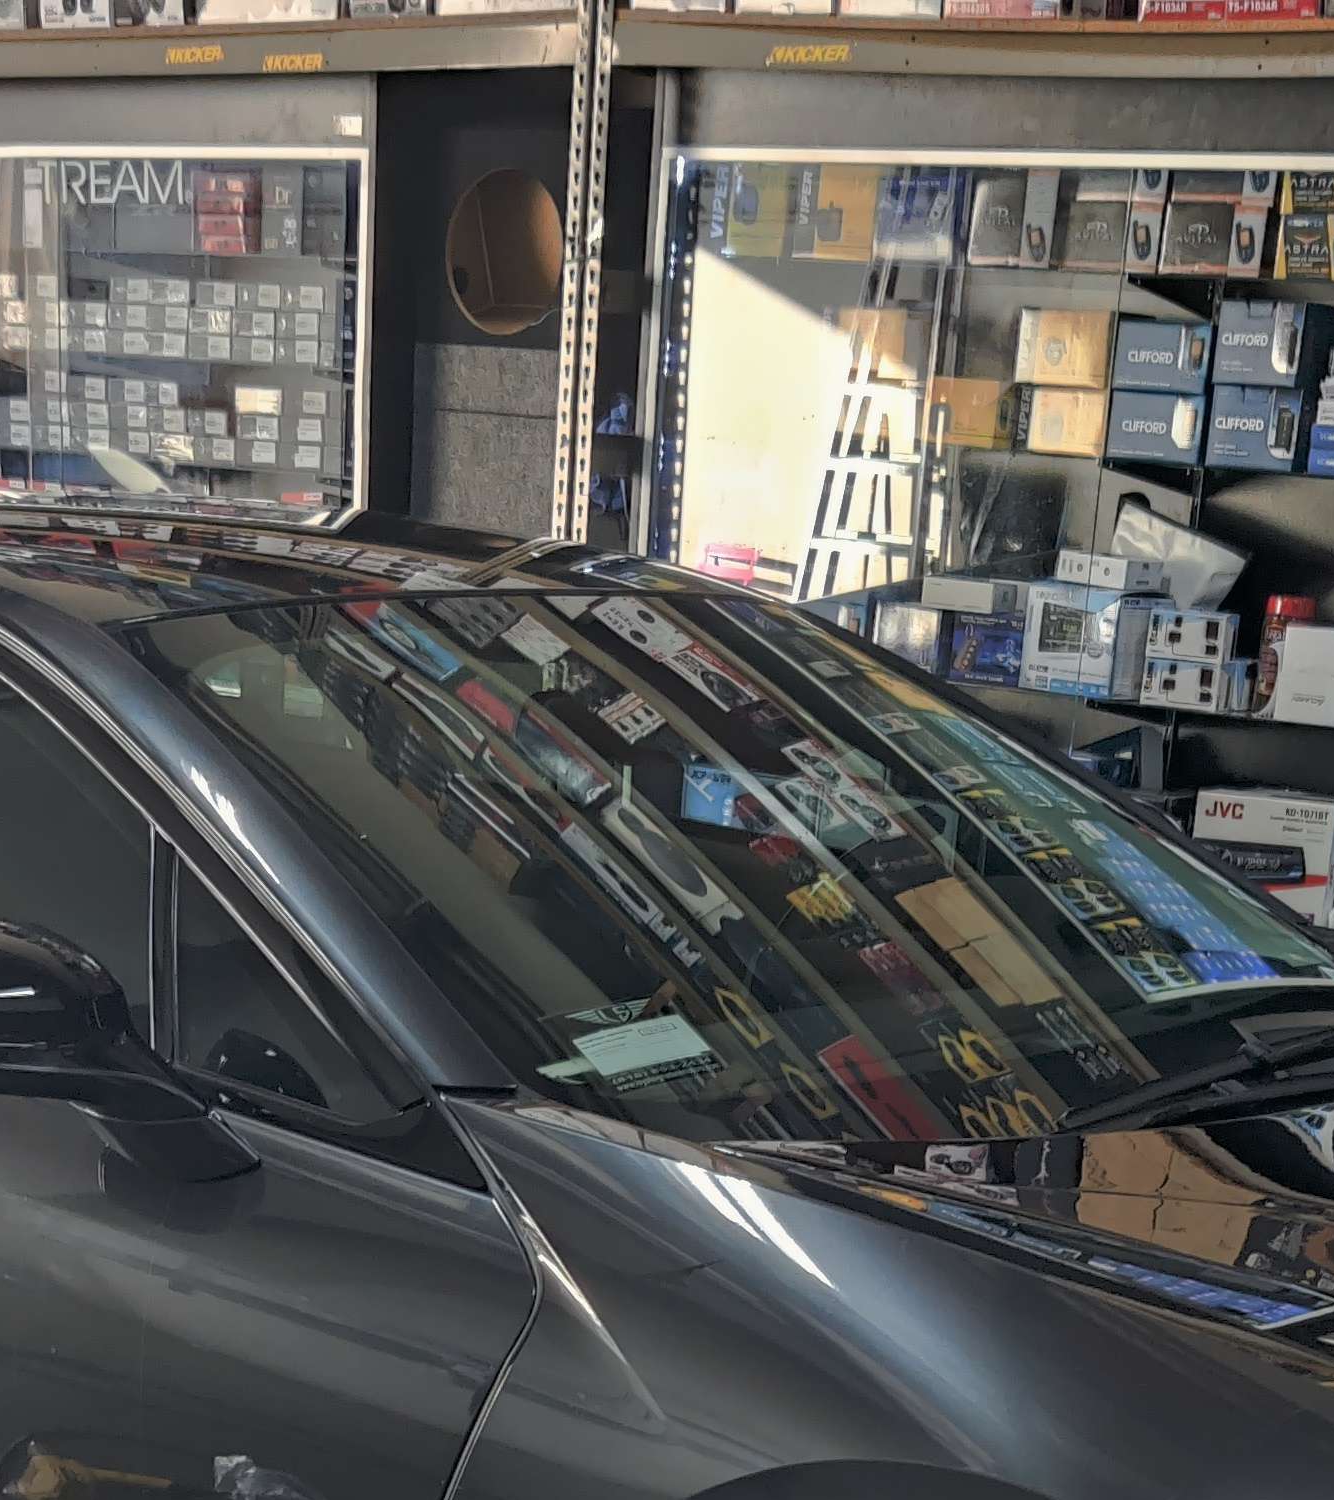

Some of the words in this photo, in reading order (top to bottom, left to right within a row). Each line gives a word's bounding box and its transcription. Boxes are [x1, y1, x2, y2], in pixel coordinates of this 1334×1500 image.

[175, 45, 222, 63] KICKER
[272, 53, 323, 71] KICKER
[782, 44, 850, 64] KICKER
[710, 166, 729, 238] VIPER
[799, 170, 813, 225] VIPER
[1285, 245, 1328, 256] ASTRA
[1222, 333, 1268, 346] CLIFFORD
[1128, 351, 1174, 365] CLIFFORD
[1016, 386, 1032, 441] VIPER
[1122, 420, 1167, 434] CLIFFORD
[1215, 417, 1264, 432] CLIFFORD
[1205, 800, 1244, 820] JVC
